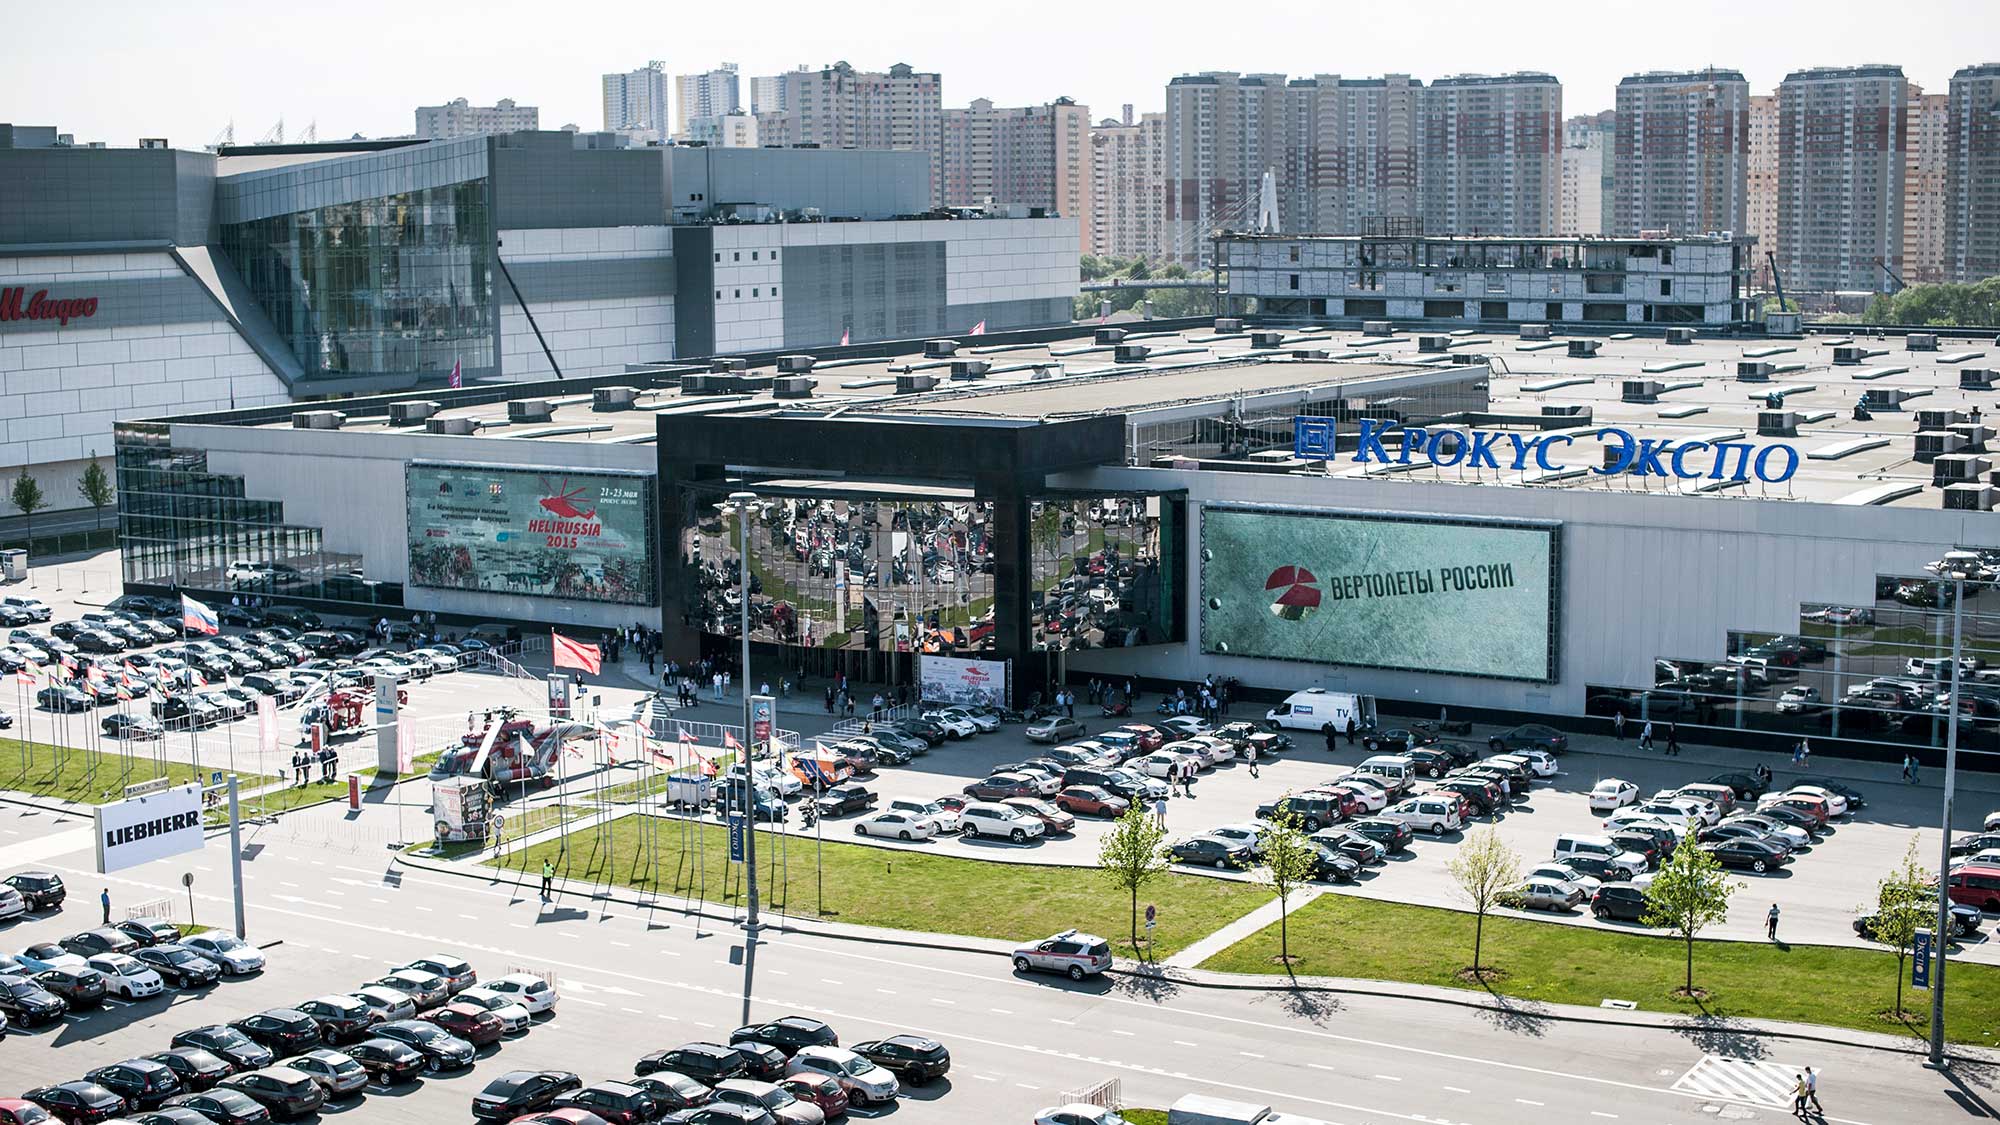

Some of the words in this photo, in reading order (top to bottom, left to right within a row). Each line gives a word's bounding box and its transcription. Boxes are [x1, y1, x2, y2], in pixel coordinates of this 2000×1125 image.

[1351, 418, 1574, 471] КРОКУС
[1592, 428, 1799, 483] ЭКСПО
[528, 519, 601, 537] HELIRUSSIA
[546, 535, 578, 549] 2015
[1331, 569, 1434, 600] ВЕРТОЛЕТЫ
[1440, 562, 1515, 592] РОССИИ
[1336, 708, 1349, 718] TV
[106, 810, 199, 847] LIEBHERR
[1916, 937, 1927, 973] ЭКСПО
